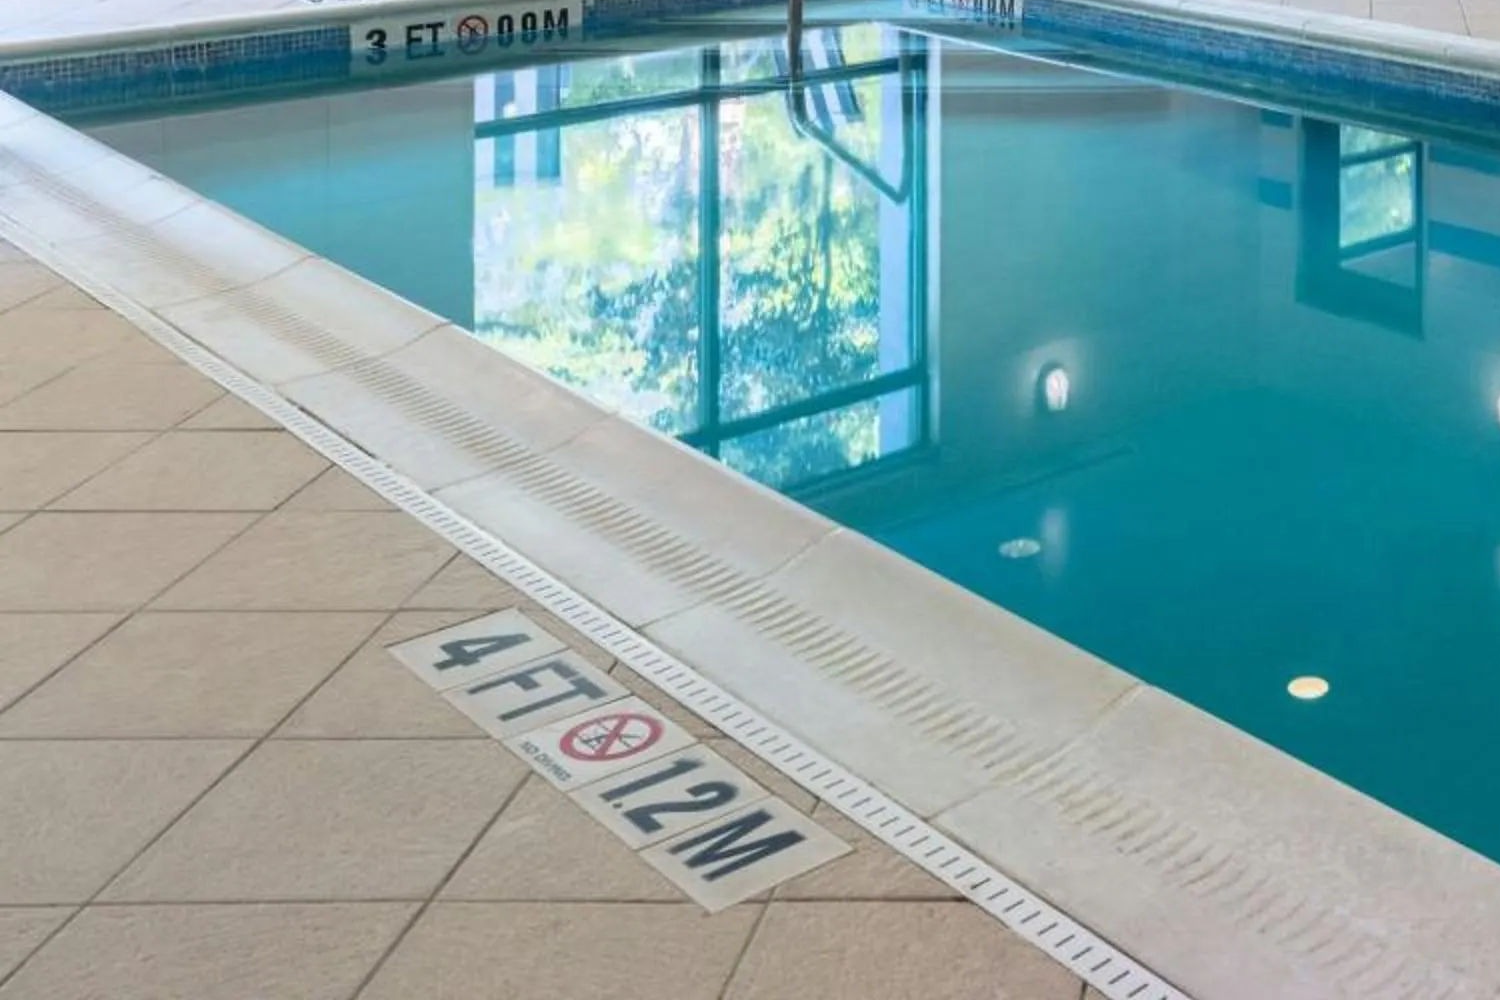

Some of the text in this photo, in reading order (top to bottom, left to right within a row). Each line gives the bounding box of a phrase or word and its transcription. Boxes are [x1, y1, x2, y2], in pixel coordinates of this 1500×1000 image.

[405, 22, 446, 48] FT
[432, 633, 533, 671] 4
[466, 659, 608, 722] FT
